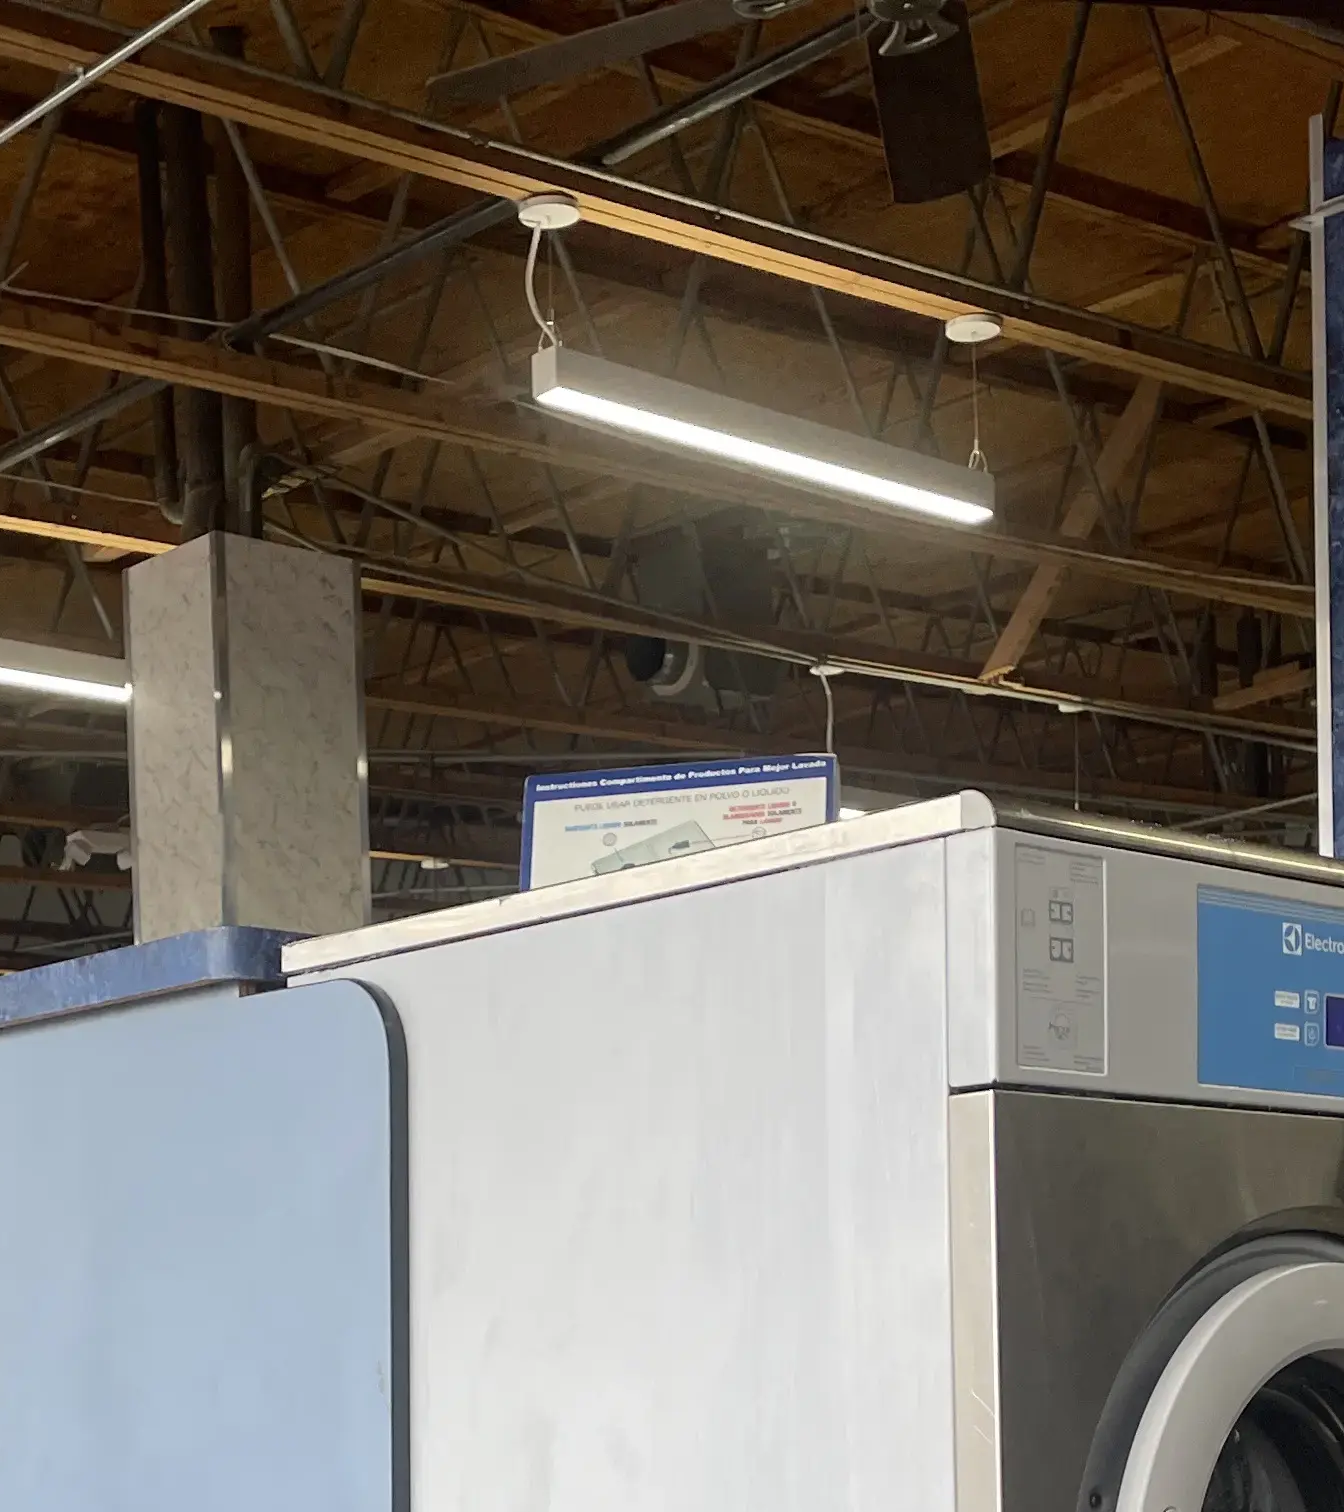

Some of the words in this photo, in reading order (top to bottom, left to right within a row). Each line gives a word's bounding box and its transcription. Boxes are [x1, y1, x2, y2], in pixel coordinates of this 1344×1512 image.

[673, 772, 686, 781] de
[687, 768, 737, 779] Productos
[738, 766, 761, 775] Para
[762, 763, 790, 773] Mejor
[695, 792, 707, 802] EN
